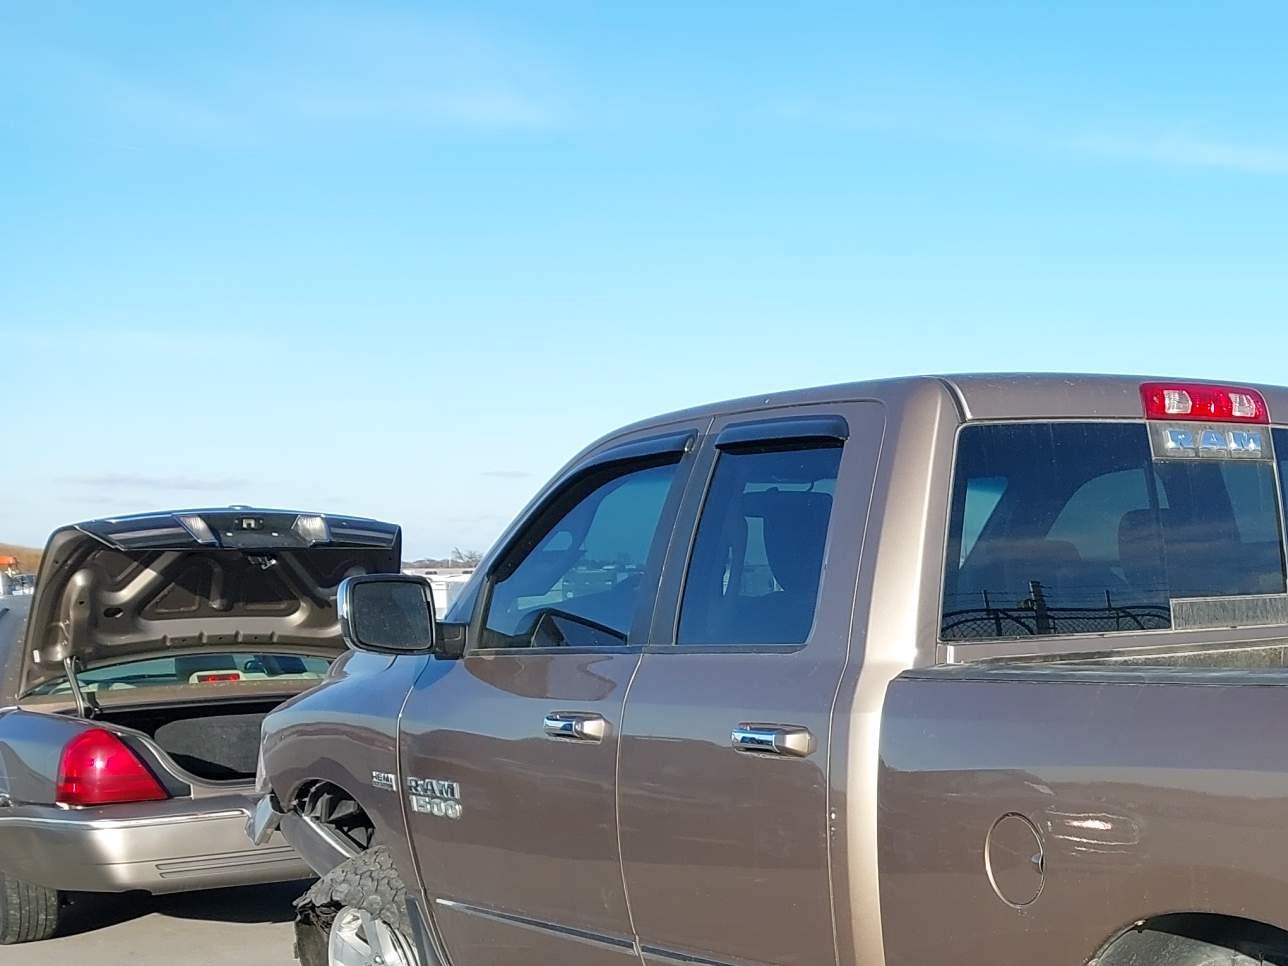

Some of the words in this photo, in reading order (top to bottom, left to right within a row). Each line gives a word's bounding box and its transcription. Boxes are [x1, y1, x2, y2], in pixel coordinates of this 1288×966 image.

[1162, 427, 1263, 458] RAM
[406, 776, 460, 800] RAM
[409, 795, 462, 819] 1500
